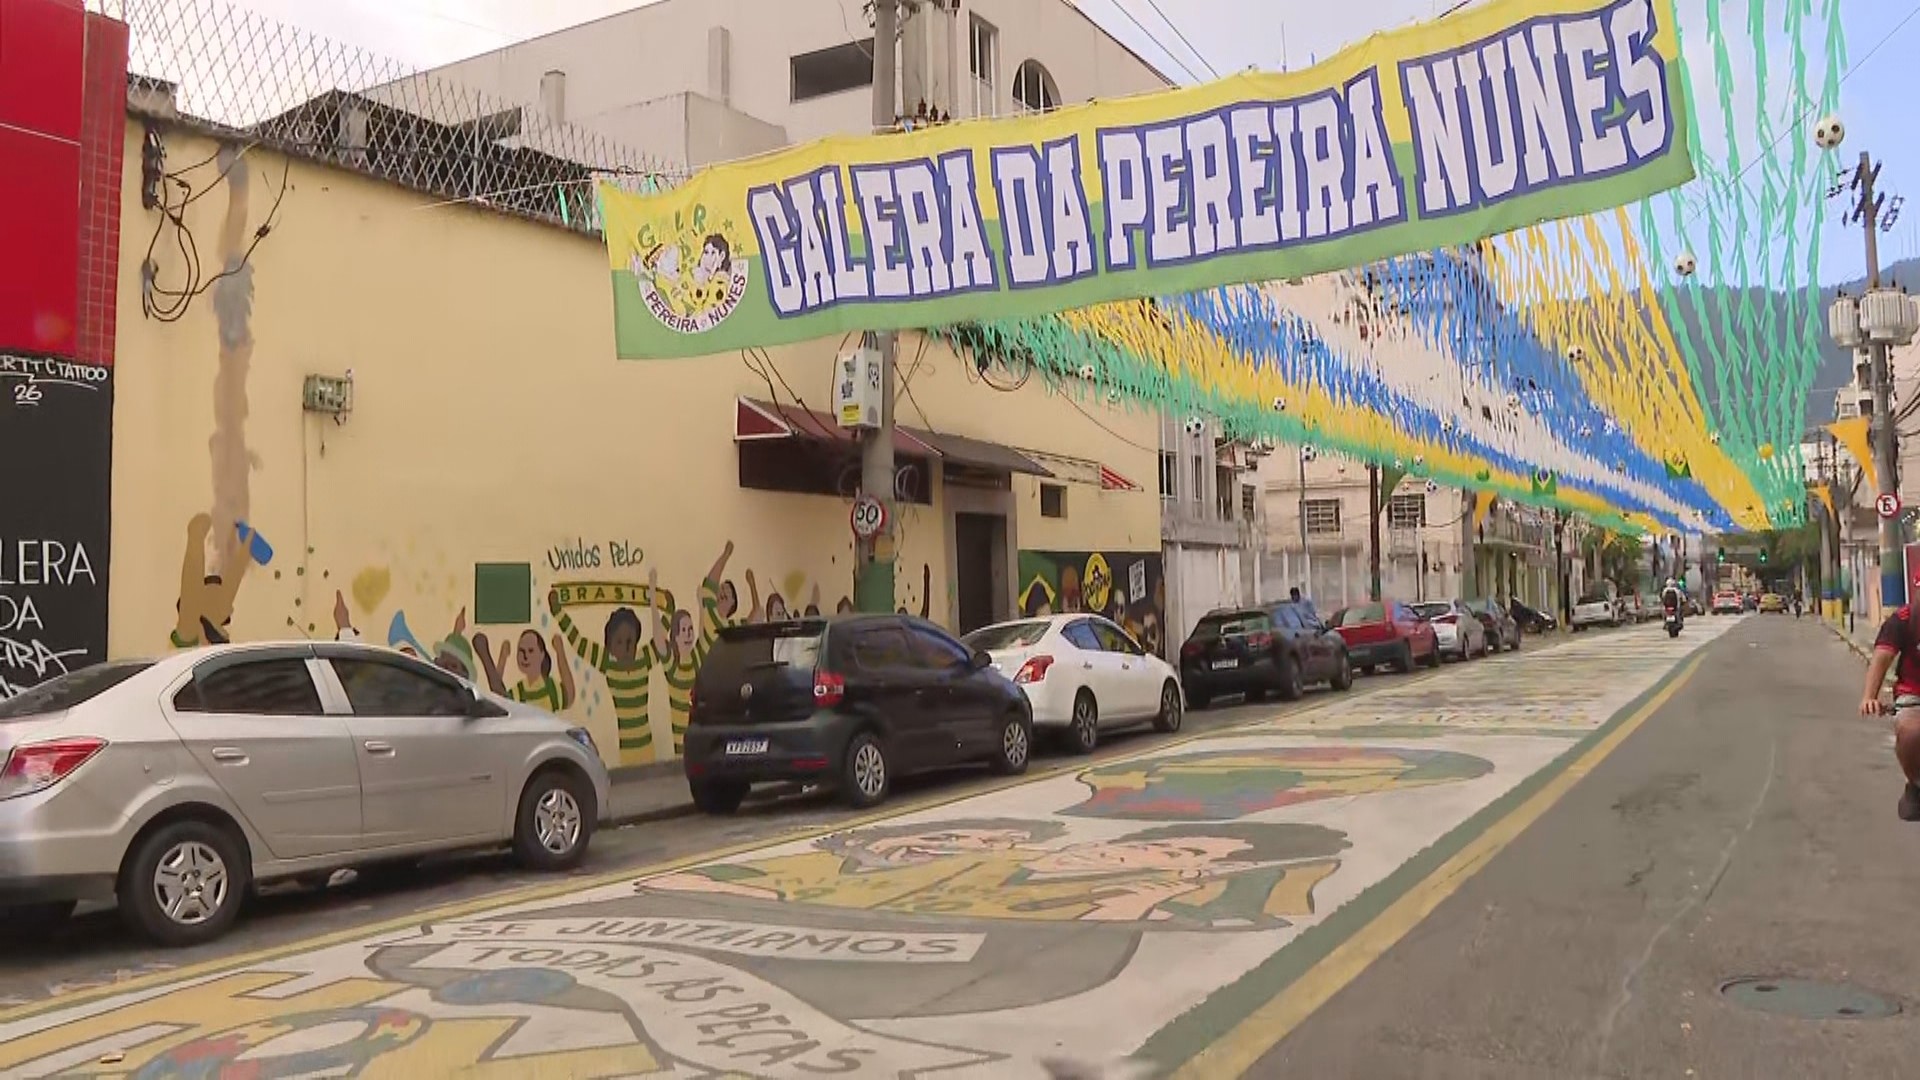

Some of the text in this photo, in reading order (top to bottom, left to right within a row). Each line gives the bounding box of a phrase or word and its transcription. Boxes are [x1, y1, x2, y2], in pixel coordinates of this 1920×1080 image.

[748, 0, 1674, 319] GALERA DA PEREIRA NUNES
[645, 273, 747, 333] PEREIRA NUNES
[14, 384, 43, 401] 26
[547, 536, 601, 572] Unidos
[559, 586, 651, 602] BRASIL
[451, 919, 958, 957] SE JUNTARMOS
[468, 946, 682, 979] TODAS
[644, 975, 745, 1002] AS
